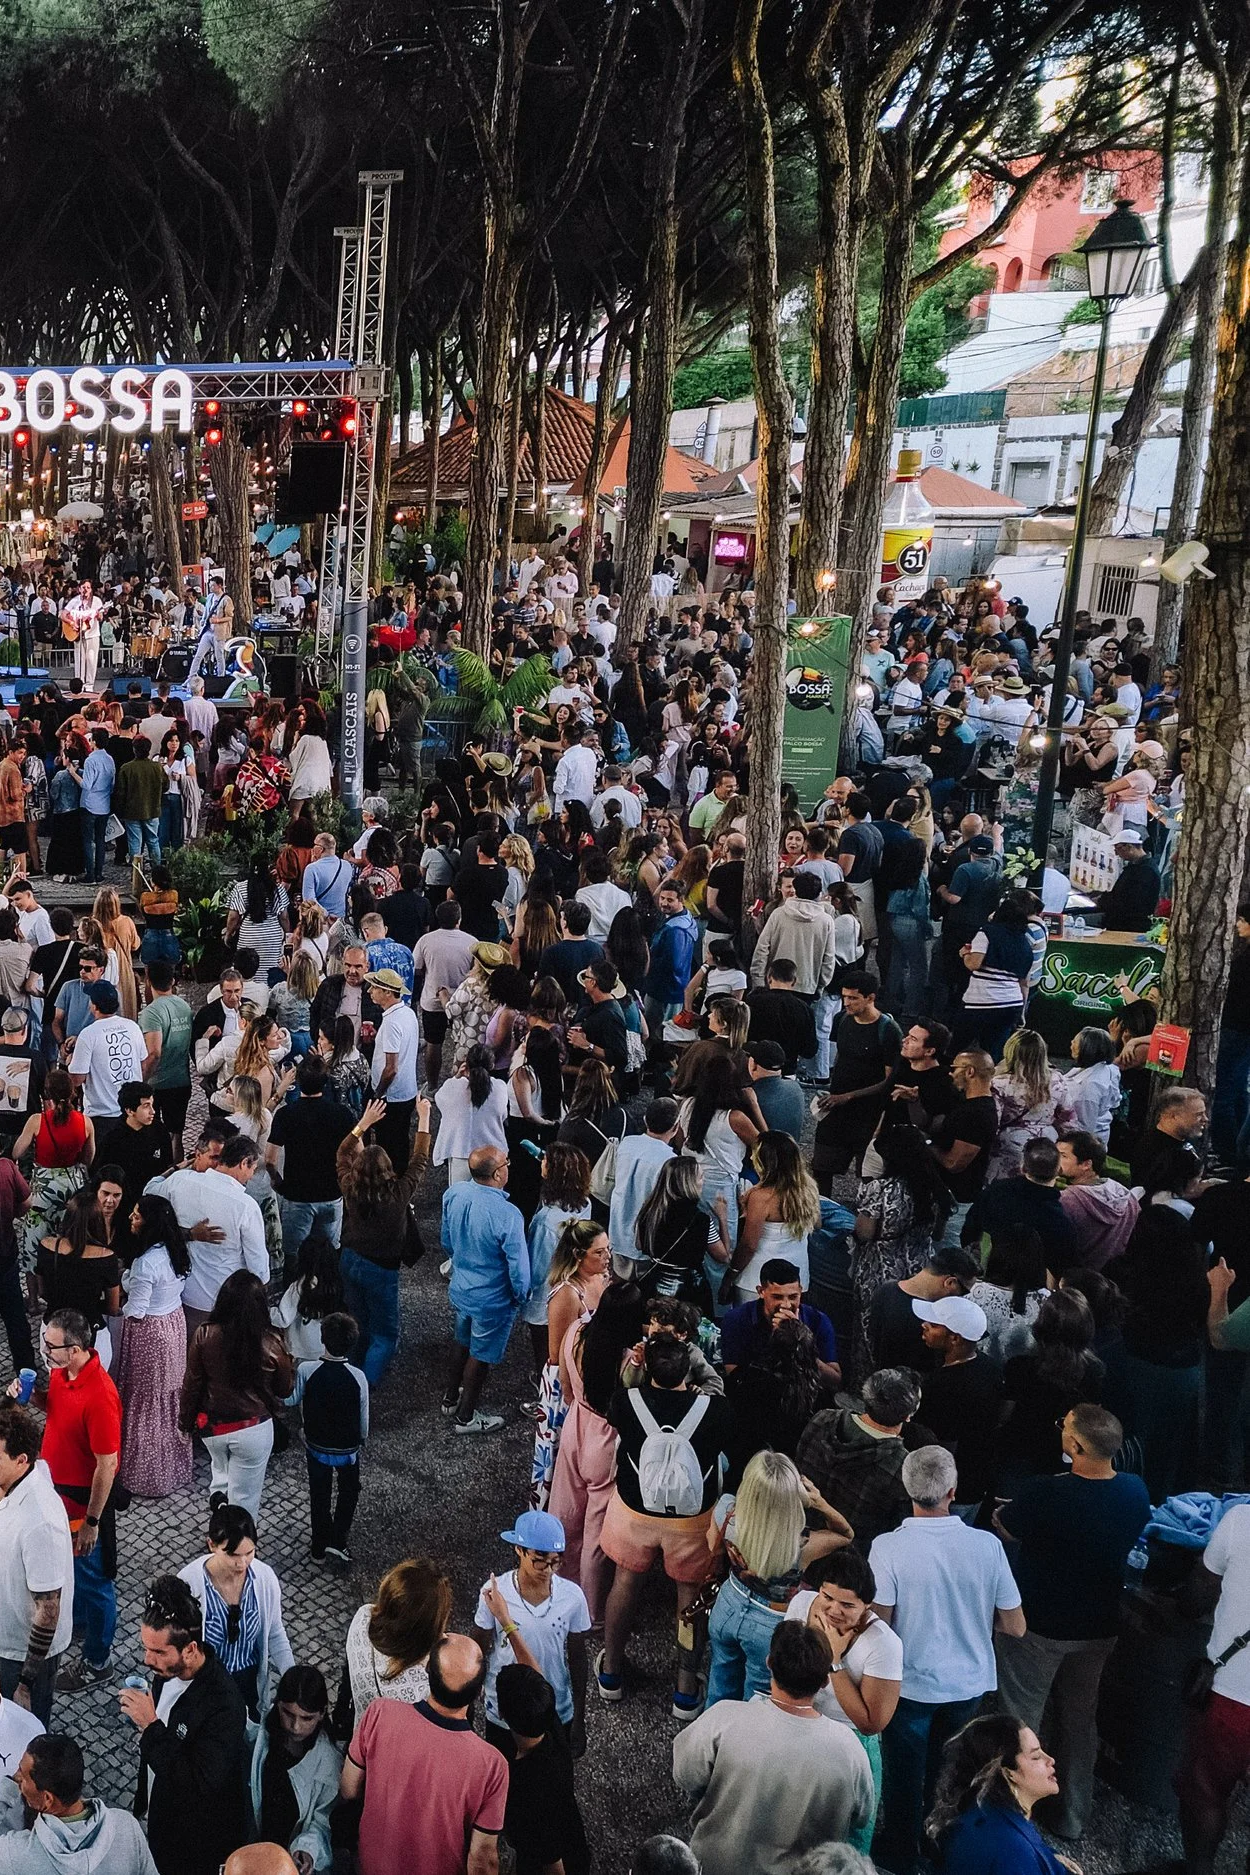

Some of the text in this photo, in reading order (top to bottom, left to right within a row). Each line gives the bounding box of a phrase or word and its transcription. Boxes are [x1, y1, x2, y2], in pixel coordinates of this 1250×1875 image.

[903, 550, 924, 569] 51
[789, 683, 830, 694] BOSSA
[344, 692, 358, 758] CASCAIS
[1074, 1000, 1111, 1010] ORIGINAL
[106, 1032, 123, 1084] KORS
[118, 1030, 134, 1081] KORS
